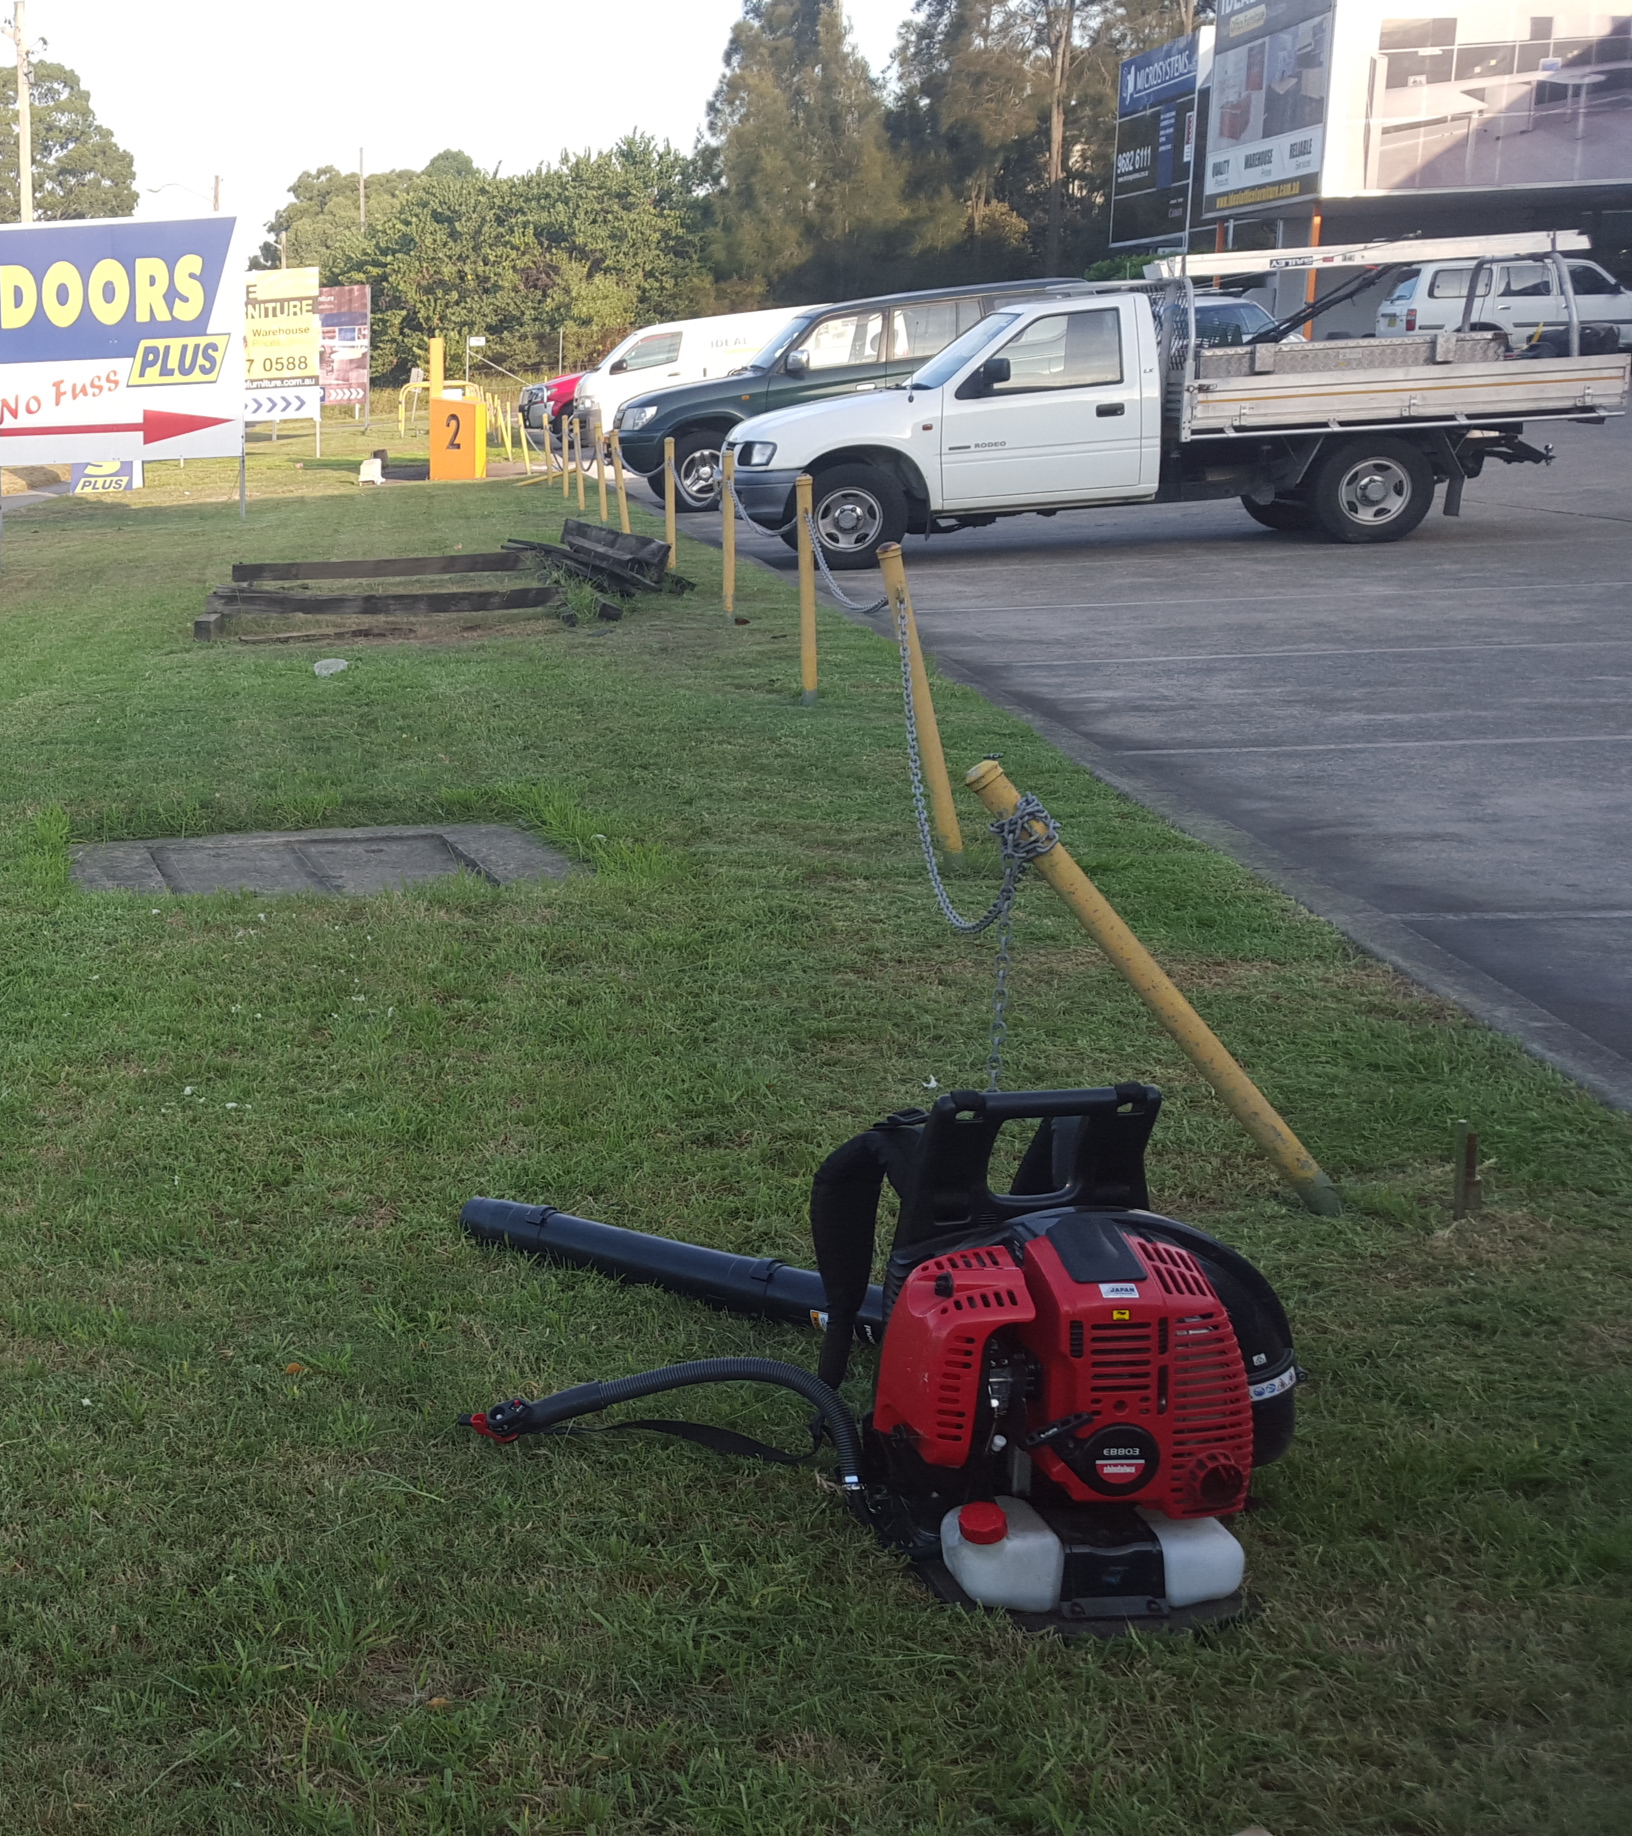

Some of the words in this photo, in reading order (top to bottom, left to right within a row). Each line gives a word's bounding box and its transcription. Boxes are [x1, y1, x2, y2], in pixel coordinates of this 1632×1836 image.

[1136, 50, 1189, 92] MICROSYSTEMS
[0, 254, 205, 329] DOORS
[252, 326, 310, 338] Warehouse
[138, 342, 219, 378] PLUS
[263, 356, 308, 372] 0588
[446, 413, 461, 449] 2
[80, 479, 124, 491] PLUS
[1103, 1447, 1140, 1456] EB803
